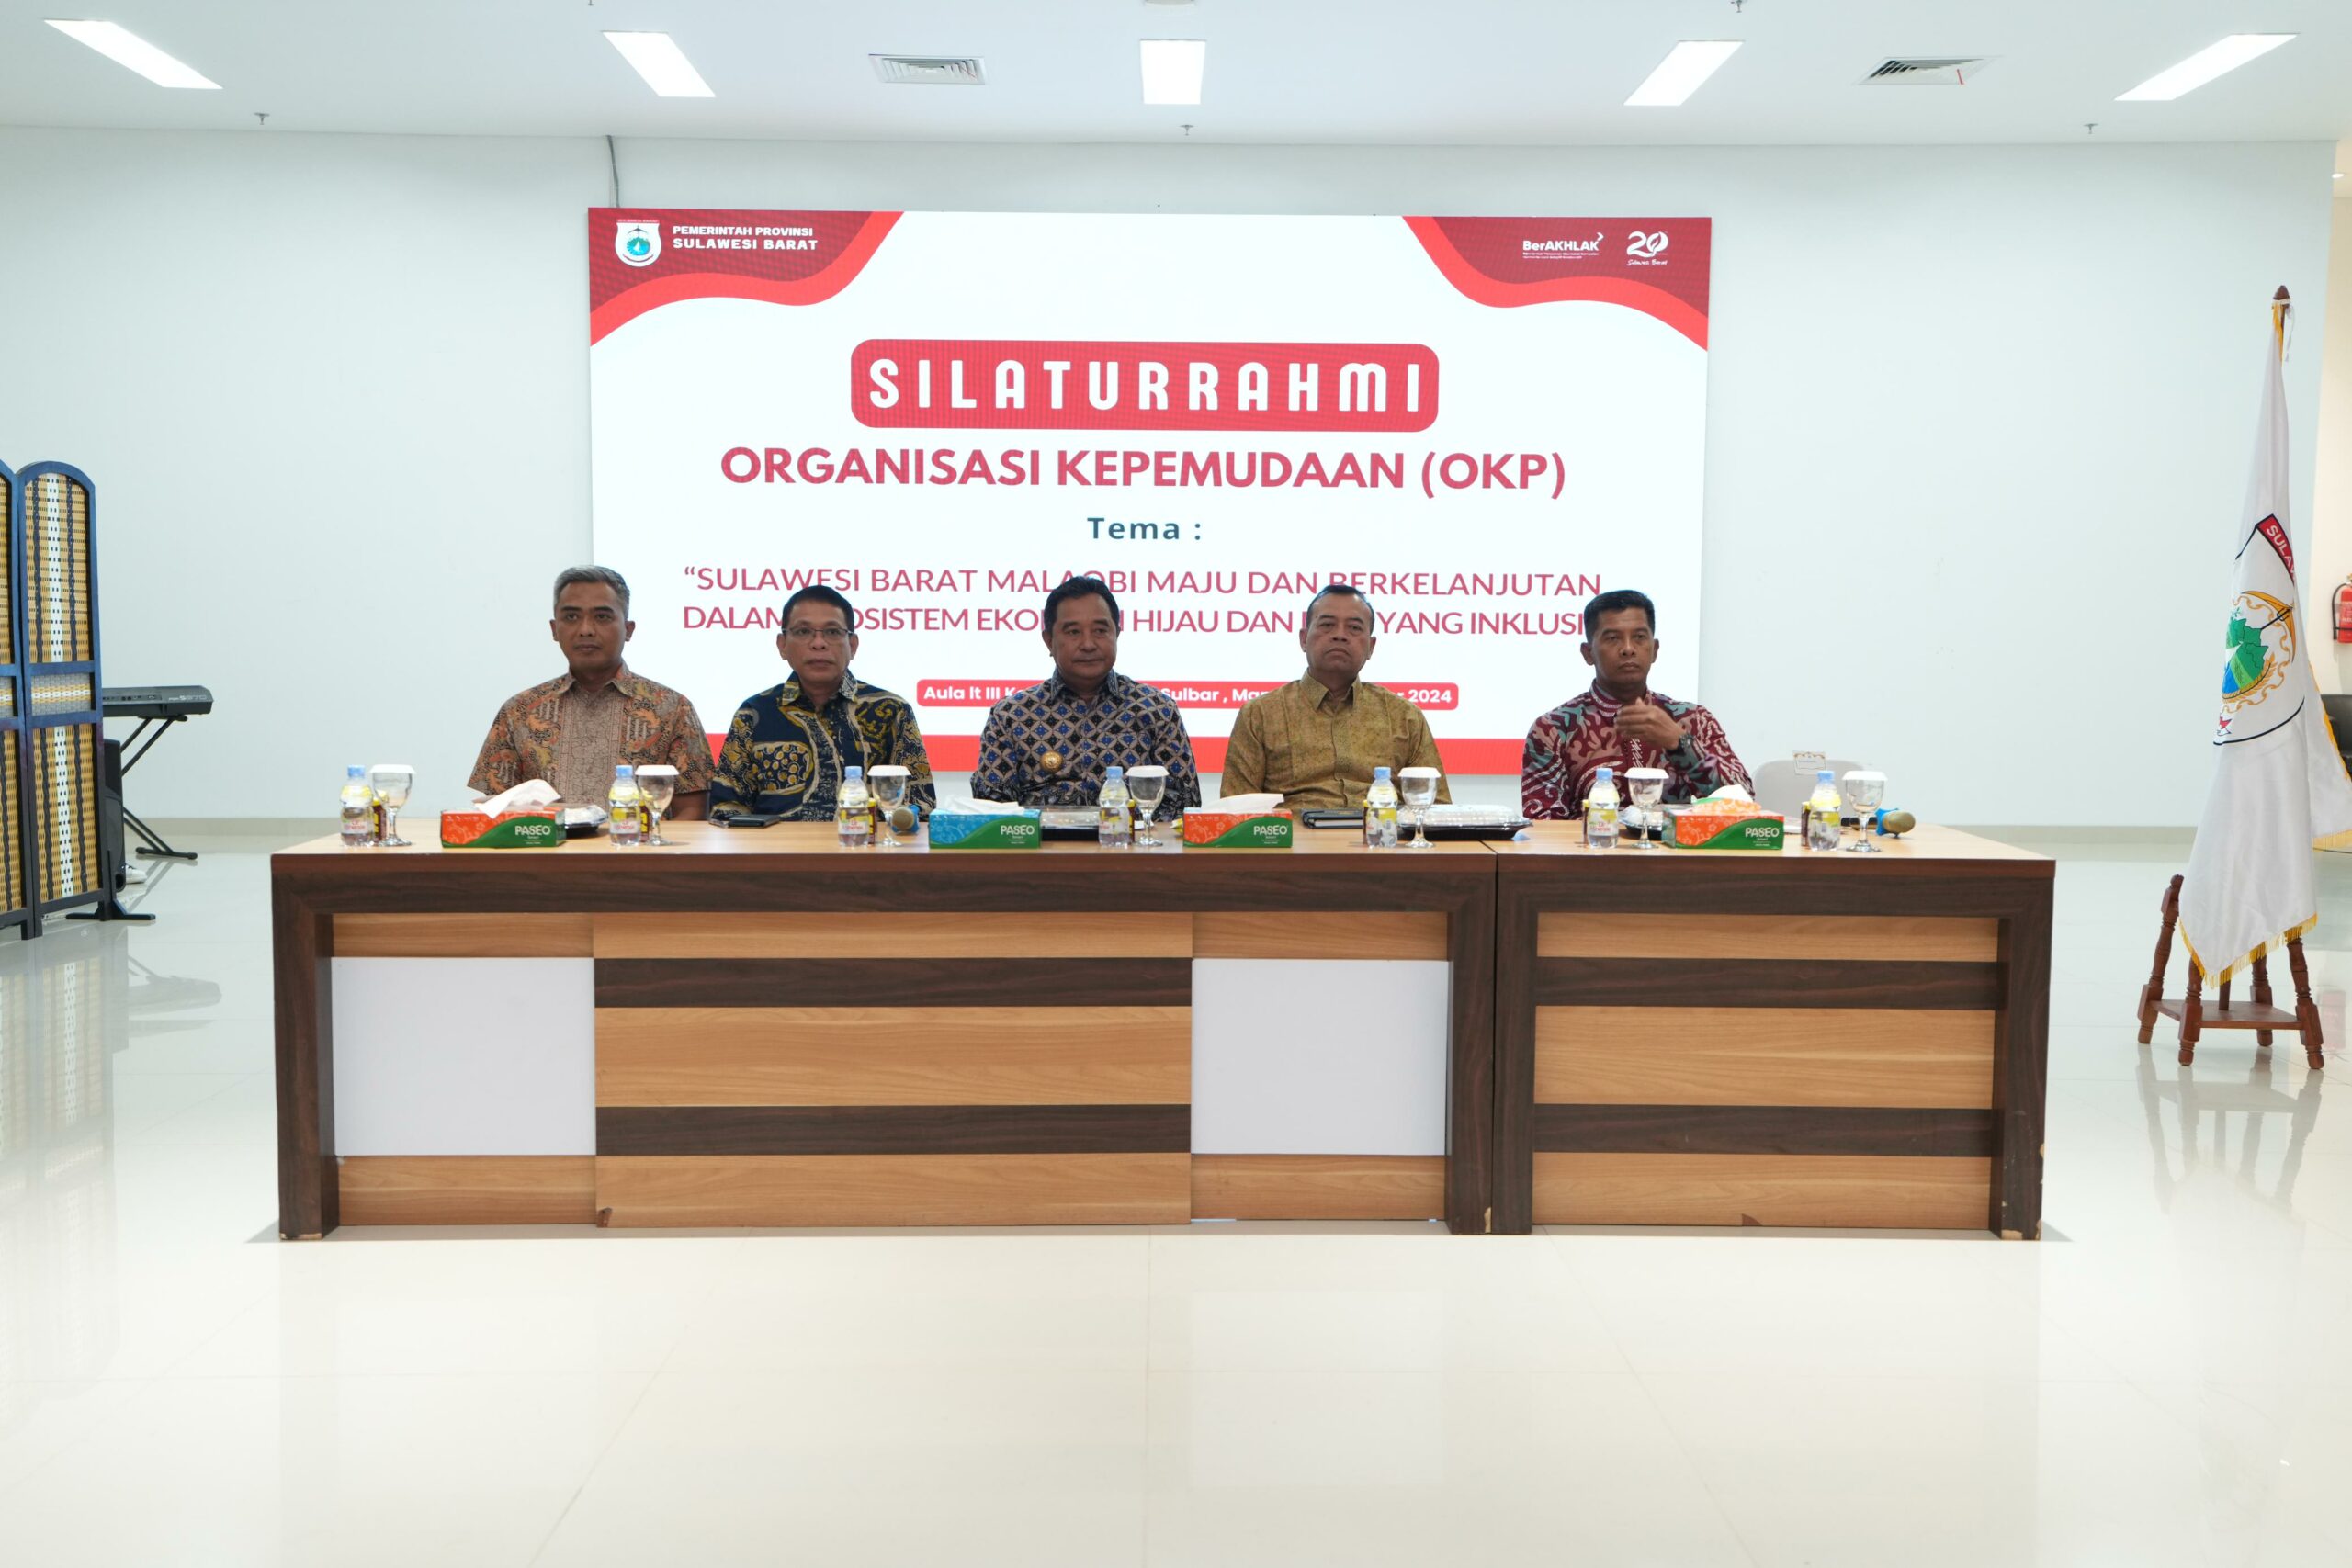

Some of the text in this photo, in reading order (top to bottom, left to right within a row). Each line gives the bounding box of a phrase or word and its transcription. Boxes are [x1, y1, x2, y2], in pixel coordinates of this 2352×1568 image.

[673, 225, 813, 237] PEMERINTAH PROVINSI
[673, 238, 819, 251] SULAWESI BARAT
[1522, 240, 1600, 252] BerAKHLAK
[1626, 231, 1668, 258] 20
[869, 357, 1420, 412] SILATURRAHMI
[721, 446, 1566, 500] ORGANISASI KEPEMUDAAN (OKP)
[1087, 517, 1182, 540] Tema
[871, 569, 978, 592] BARAT
[1148, 571, 1238, 595] MAJU
[1248, 571, 1318, 595] DAN
[1329, 572, 1601, 597] BERKELANJUTAN
[1133, 609, 1219, 633] HIJAU
[1227, 610, 1294, 634] DAN
[1375, 611, 1464, 635] YANG
[1470, 612, 1584, 636] INKLUSI
[923, 685, 966, 701] Aula
[1160, 687, 1220, 702] Sulbar
[1408, 689, 1453, 704] 2024
[514, 825, 551, 836] PASEO
[1000, 825, 1035, 836] PASEO
[1253, 825, 1288, 836] PASEO
[1745, 827, 1780, 838] PASEO
